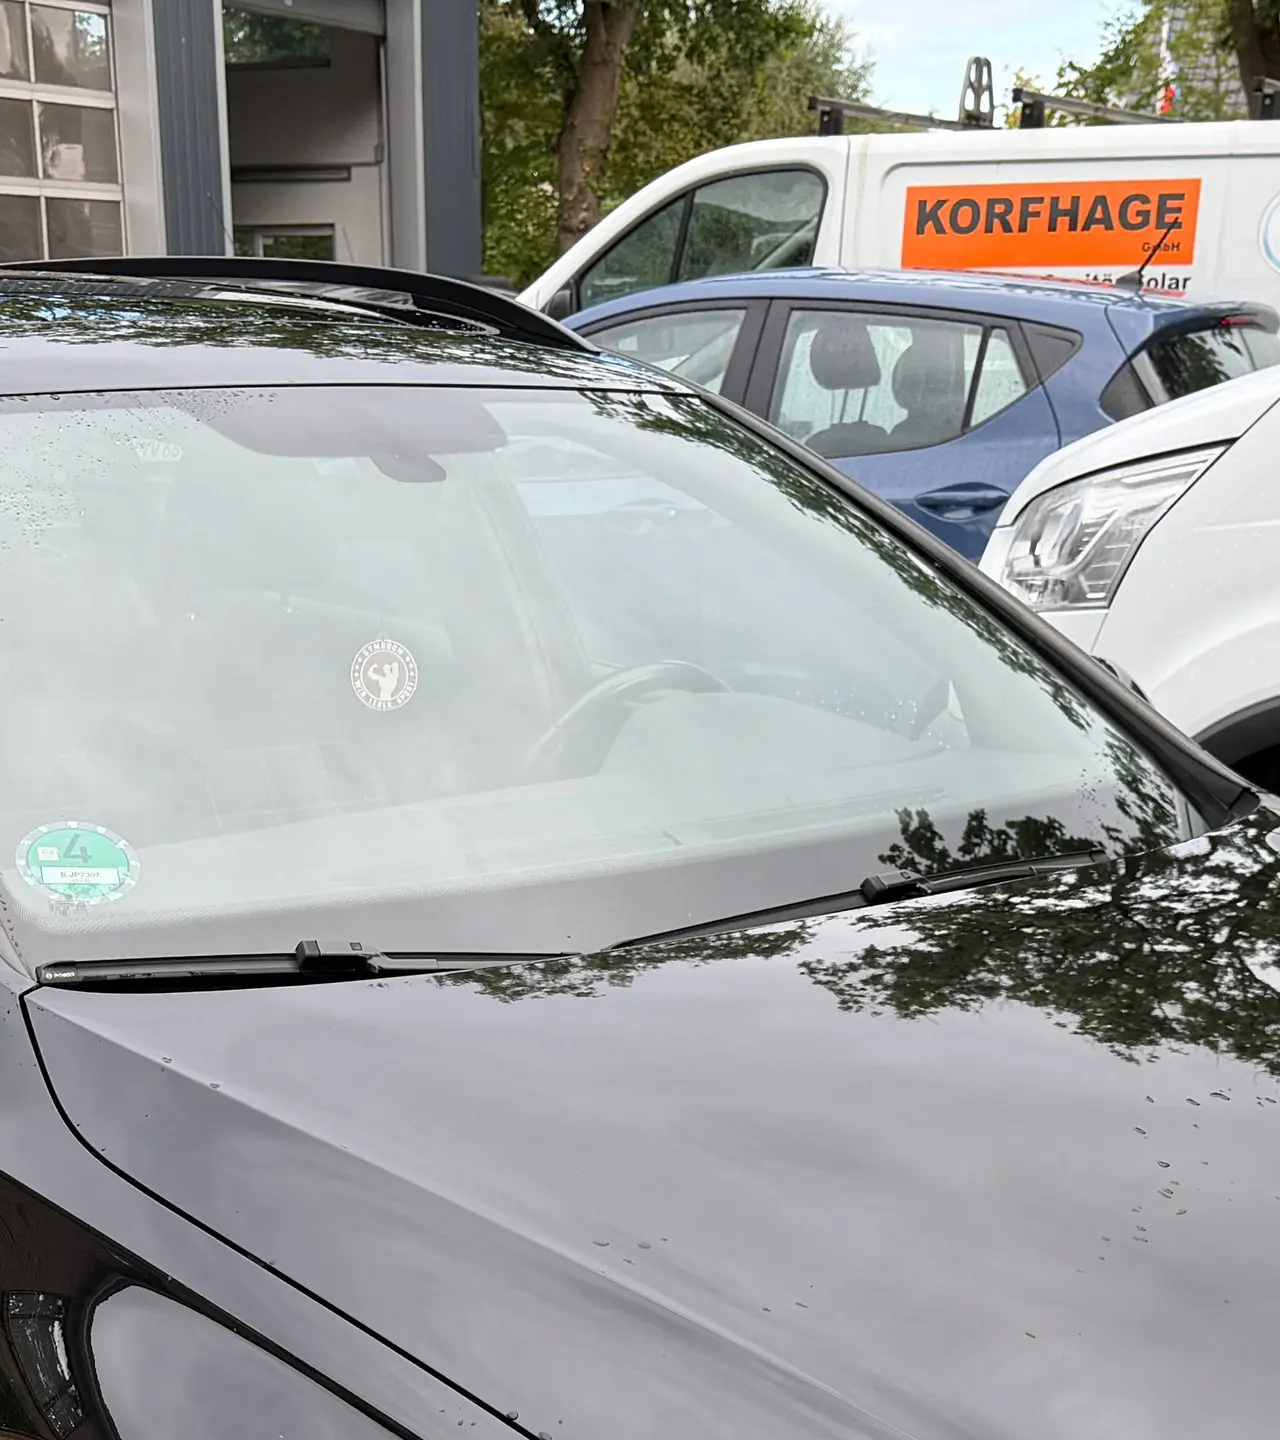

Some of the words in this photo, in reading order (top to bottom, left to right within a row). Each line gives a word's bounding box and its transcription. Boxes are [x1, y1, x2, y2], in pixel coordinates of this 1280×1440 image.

[915, 193, 1186, 236] KORFHAGE
[1139, 273, 1191, 290] olar
[63, 833, 92, 863] 4
